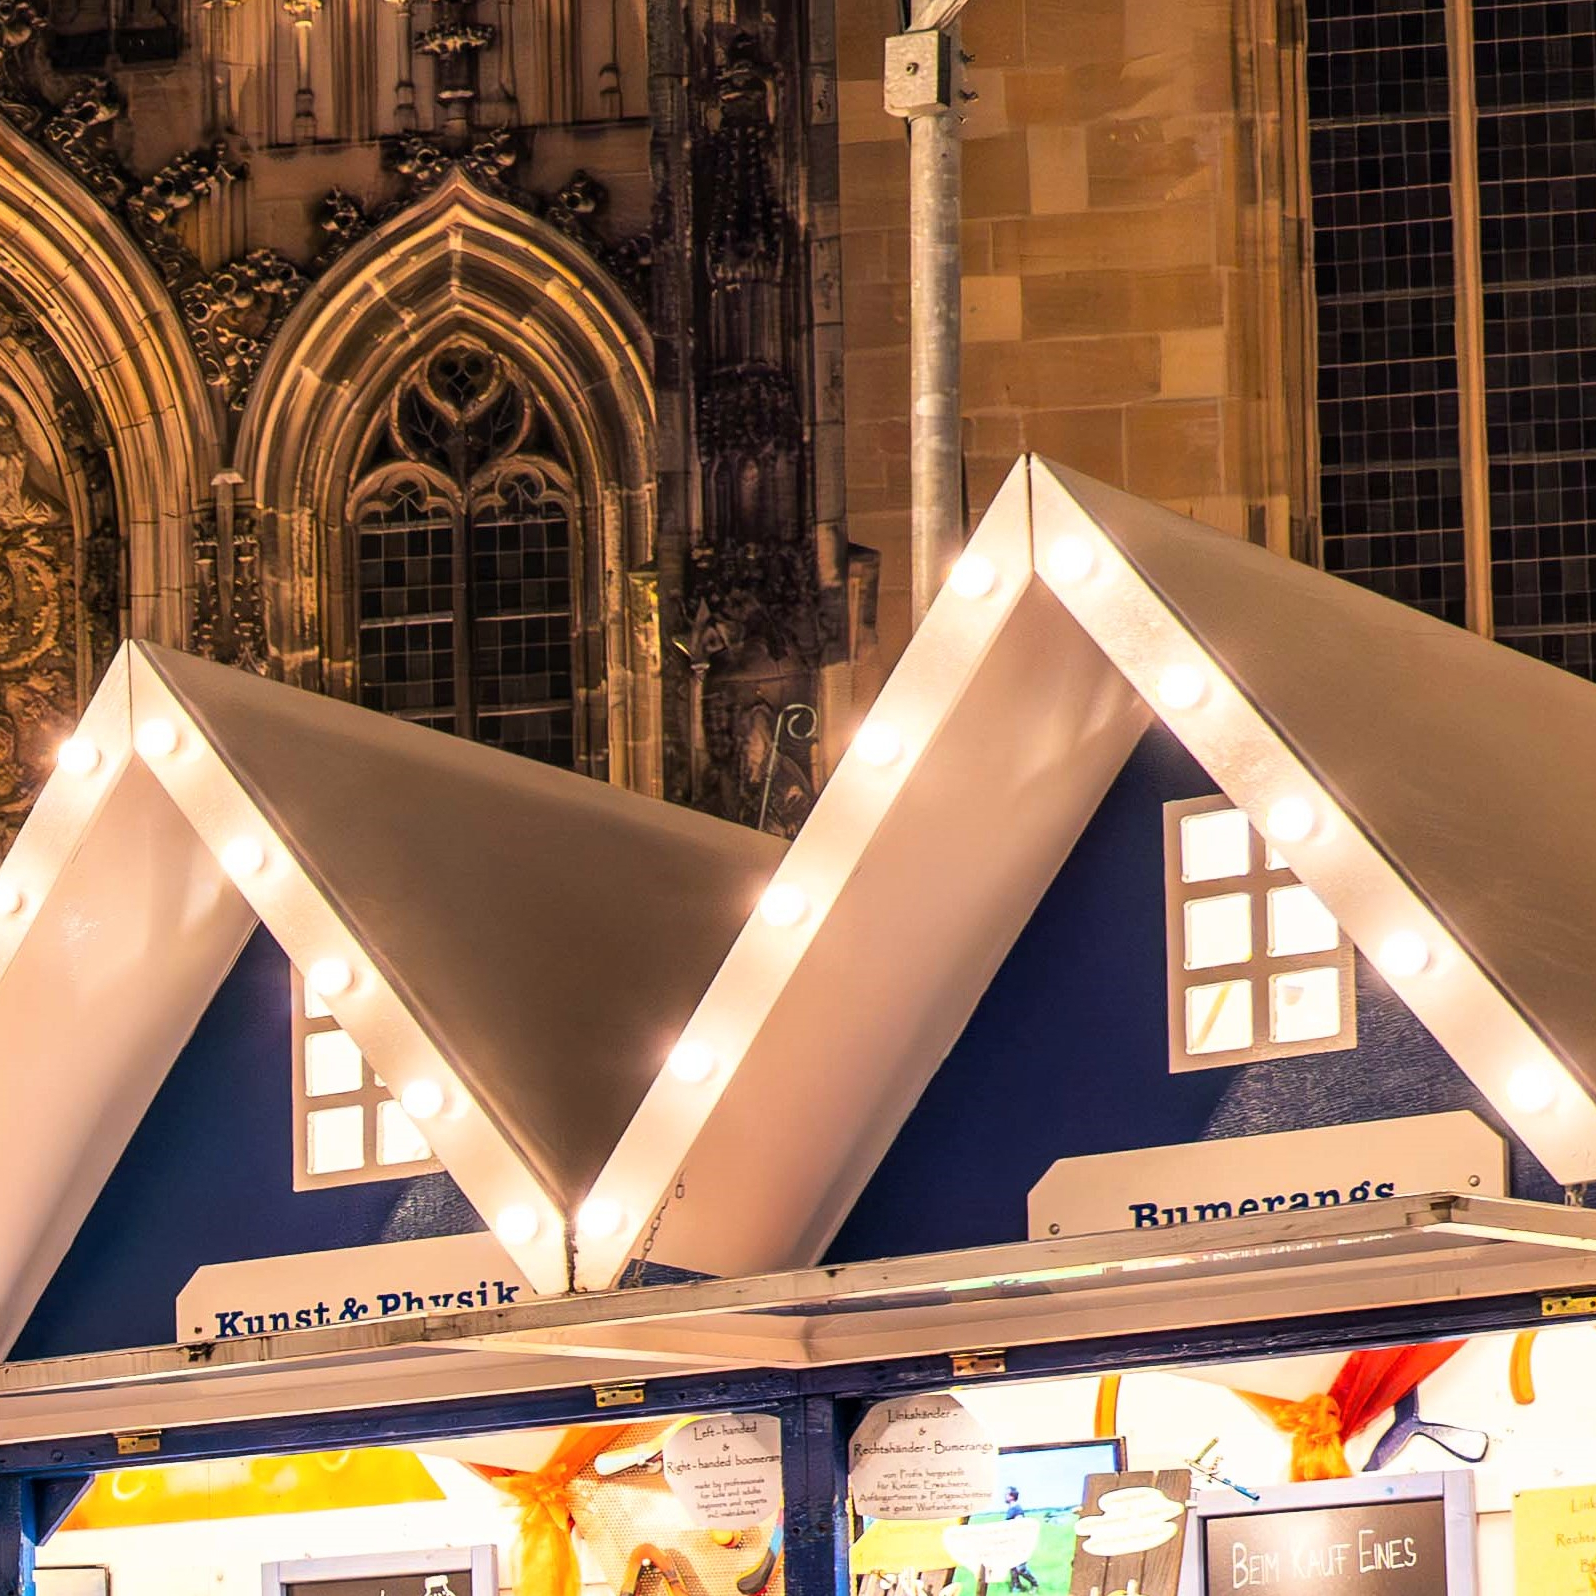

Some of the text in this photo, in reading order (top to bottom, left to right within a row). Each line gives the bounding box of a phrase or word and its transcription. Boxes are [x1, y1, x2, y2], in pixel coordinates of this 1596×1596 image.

[215, 1302, 330, 1339] Kunst
[339, 1297, 368, 1321] &
[694, 1421, 758, 1441] Left-handed
